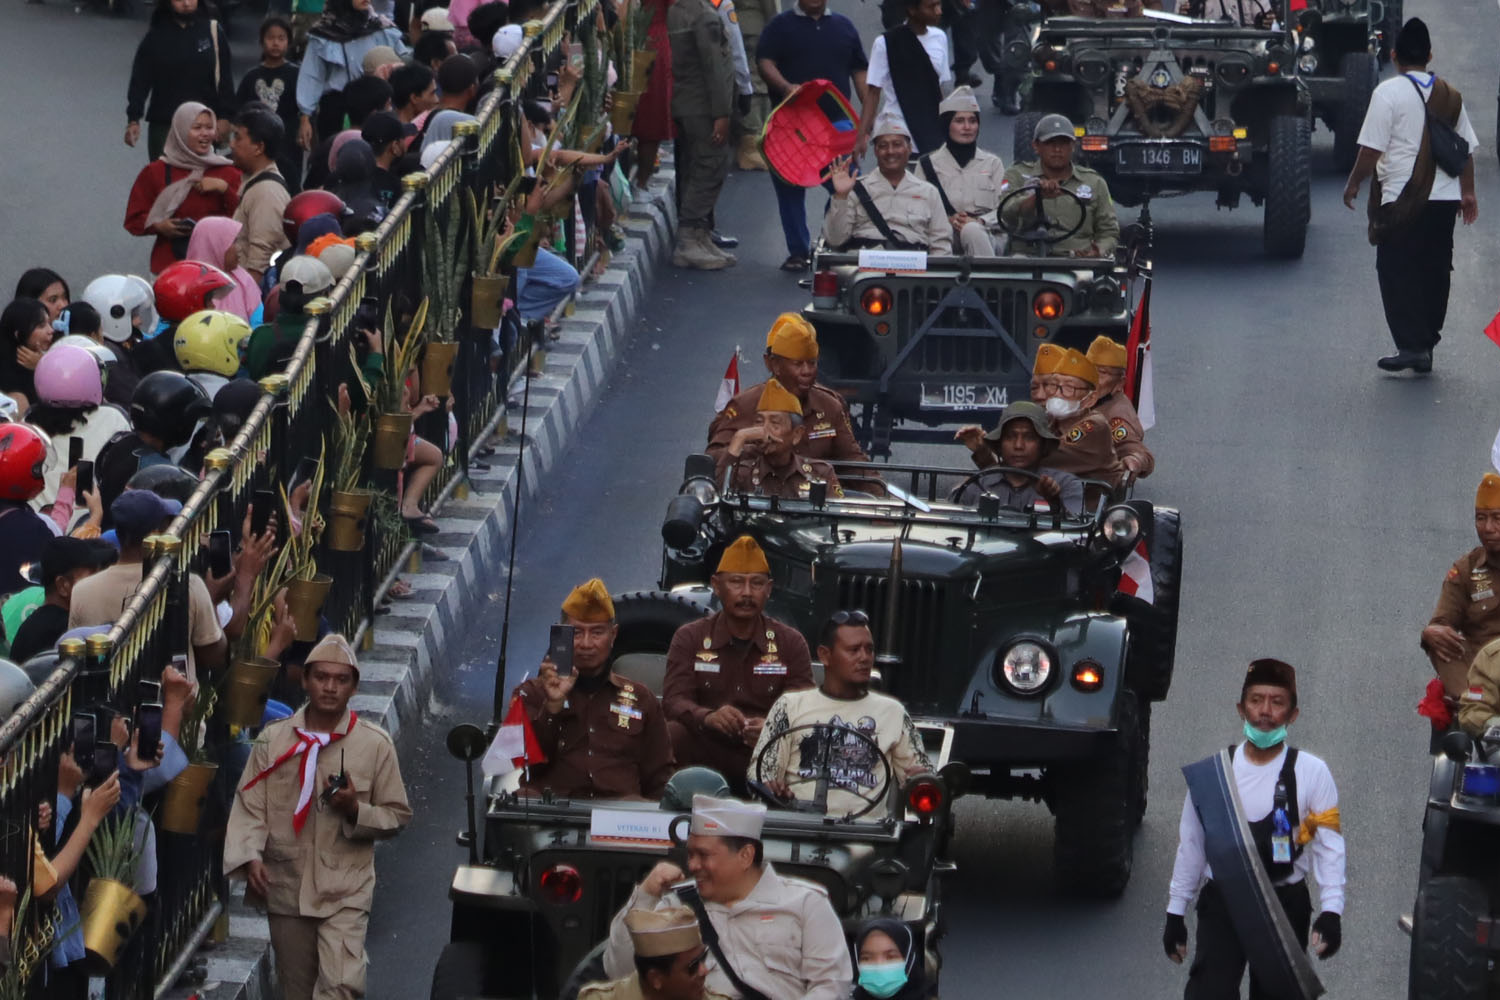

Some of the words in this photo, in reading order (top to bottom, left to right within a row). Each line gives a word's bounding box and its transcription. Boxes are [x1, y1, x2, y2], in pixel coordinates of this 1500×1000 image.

[1119, 149, 1127, 165] L
[1142, 149, 1170, 165] 1346
[1183, 149, 1199, 165] BW
[920, 382, 929, 405] L
[943, 385, 976, 404] 1195
[985, 386, 1007, 405] XM
